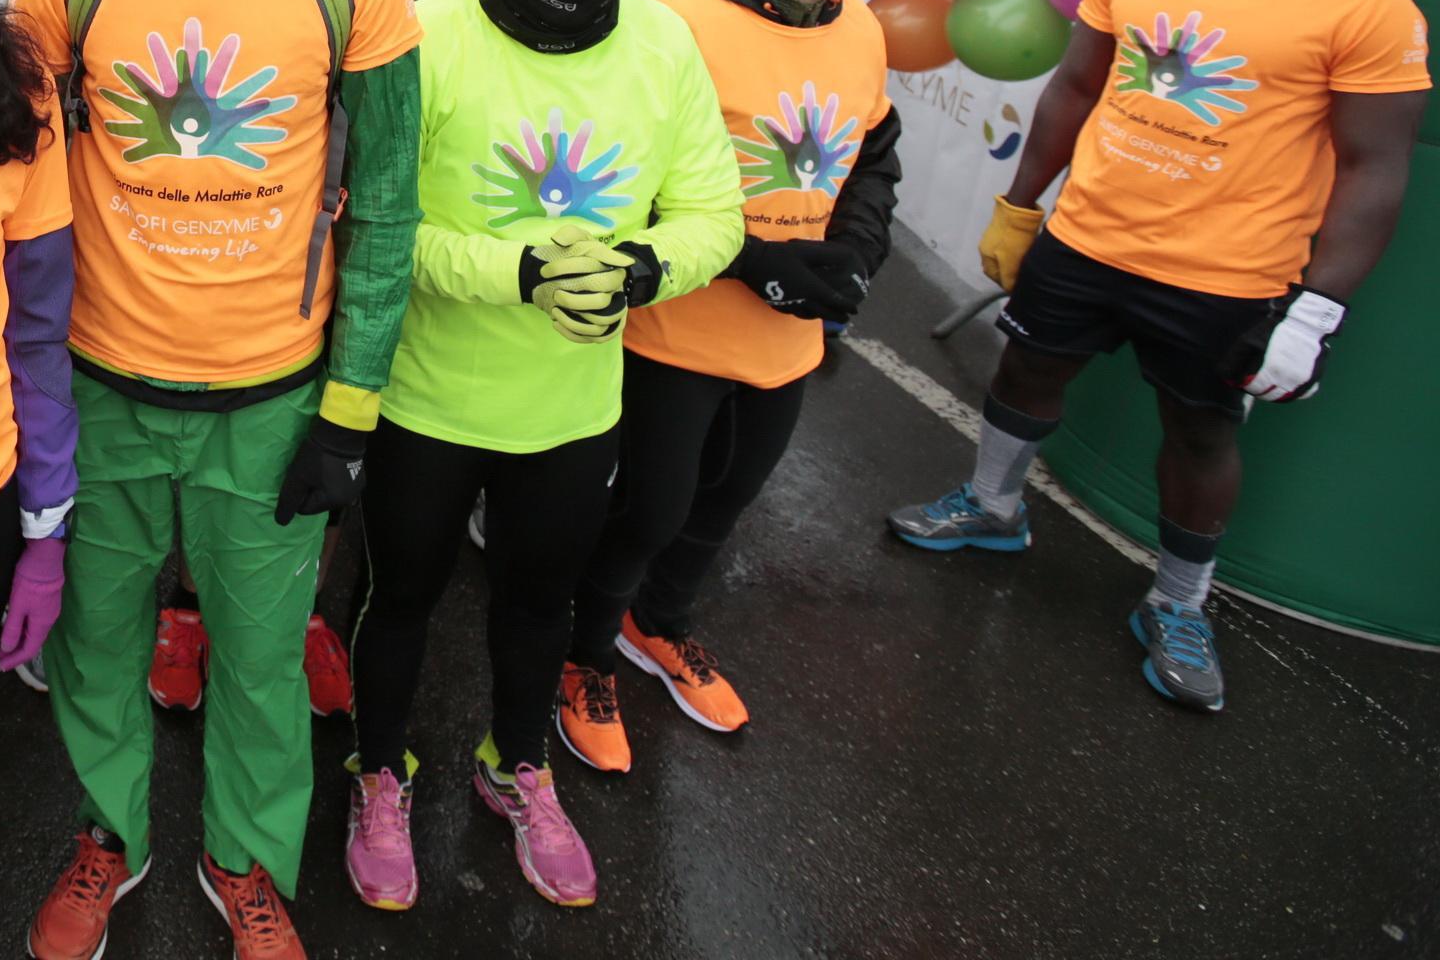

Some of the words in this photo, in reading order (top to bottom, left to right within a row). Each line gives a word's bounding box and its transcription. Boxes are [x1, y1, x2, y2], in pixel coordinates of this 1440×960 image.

[157, 187, 190, 203] delle
[194, 189, 252, 203] Malattie
[256, 184, 284, 198] Rare
[172, 216, 260, 235] GENZYME
[127, 227, 221, 263] Empowering
[225, 239, 259, 261] Life
